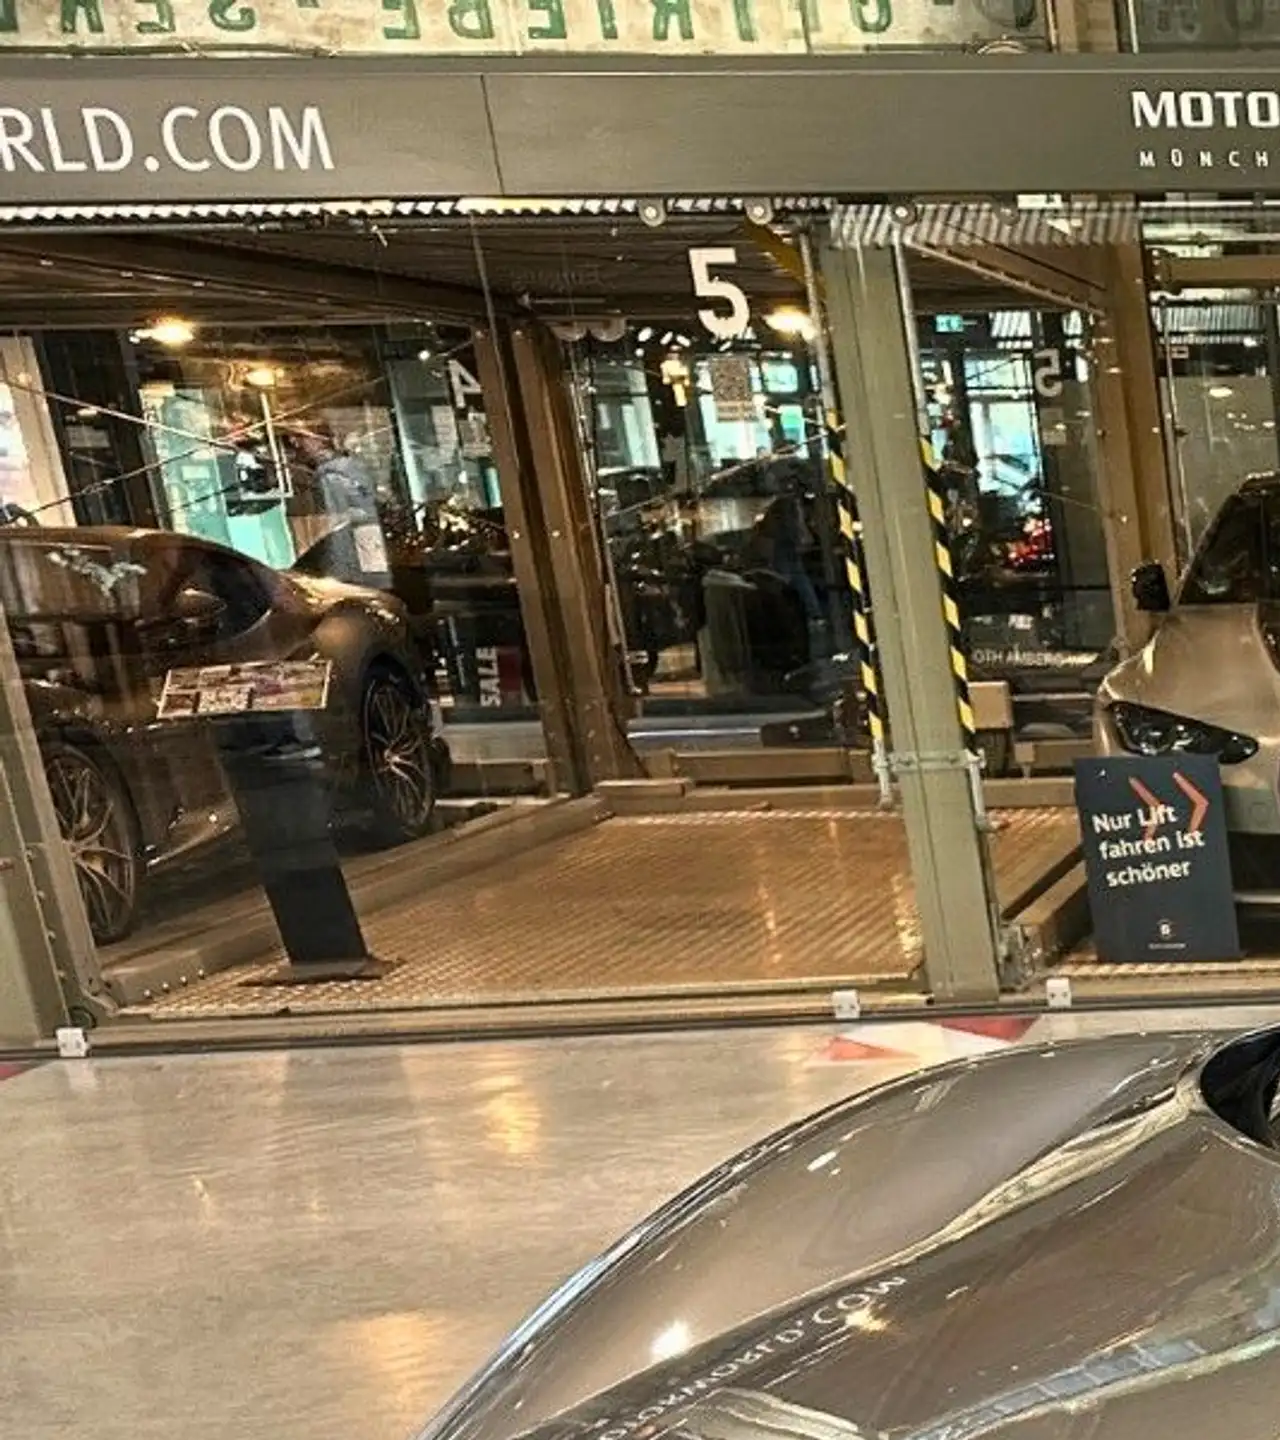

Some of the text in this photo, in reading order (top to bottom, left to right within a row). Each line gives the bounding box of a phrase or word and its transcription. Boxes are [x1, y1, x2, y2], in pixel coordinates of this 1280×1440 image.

[689, 247, 750, 340] 5
[475, 646, 501, 707] SALE
[1092, 804, 1179, 834] Nur Lift
[1099, 830, 1206, 861] fahren ist
[1105, 861, 1191, 887] schöner
